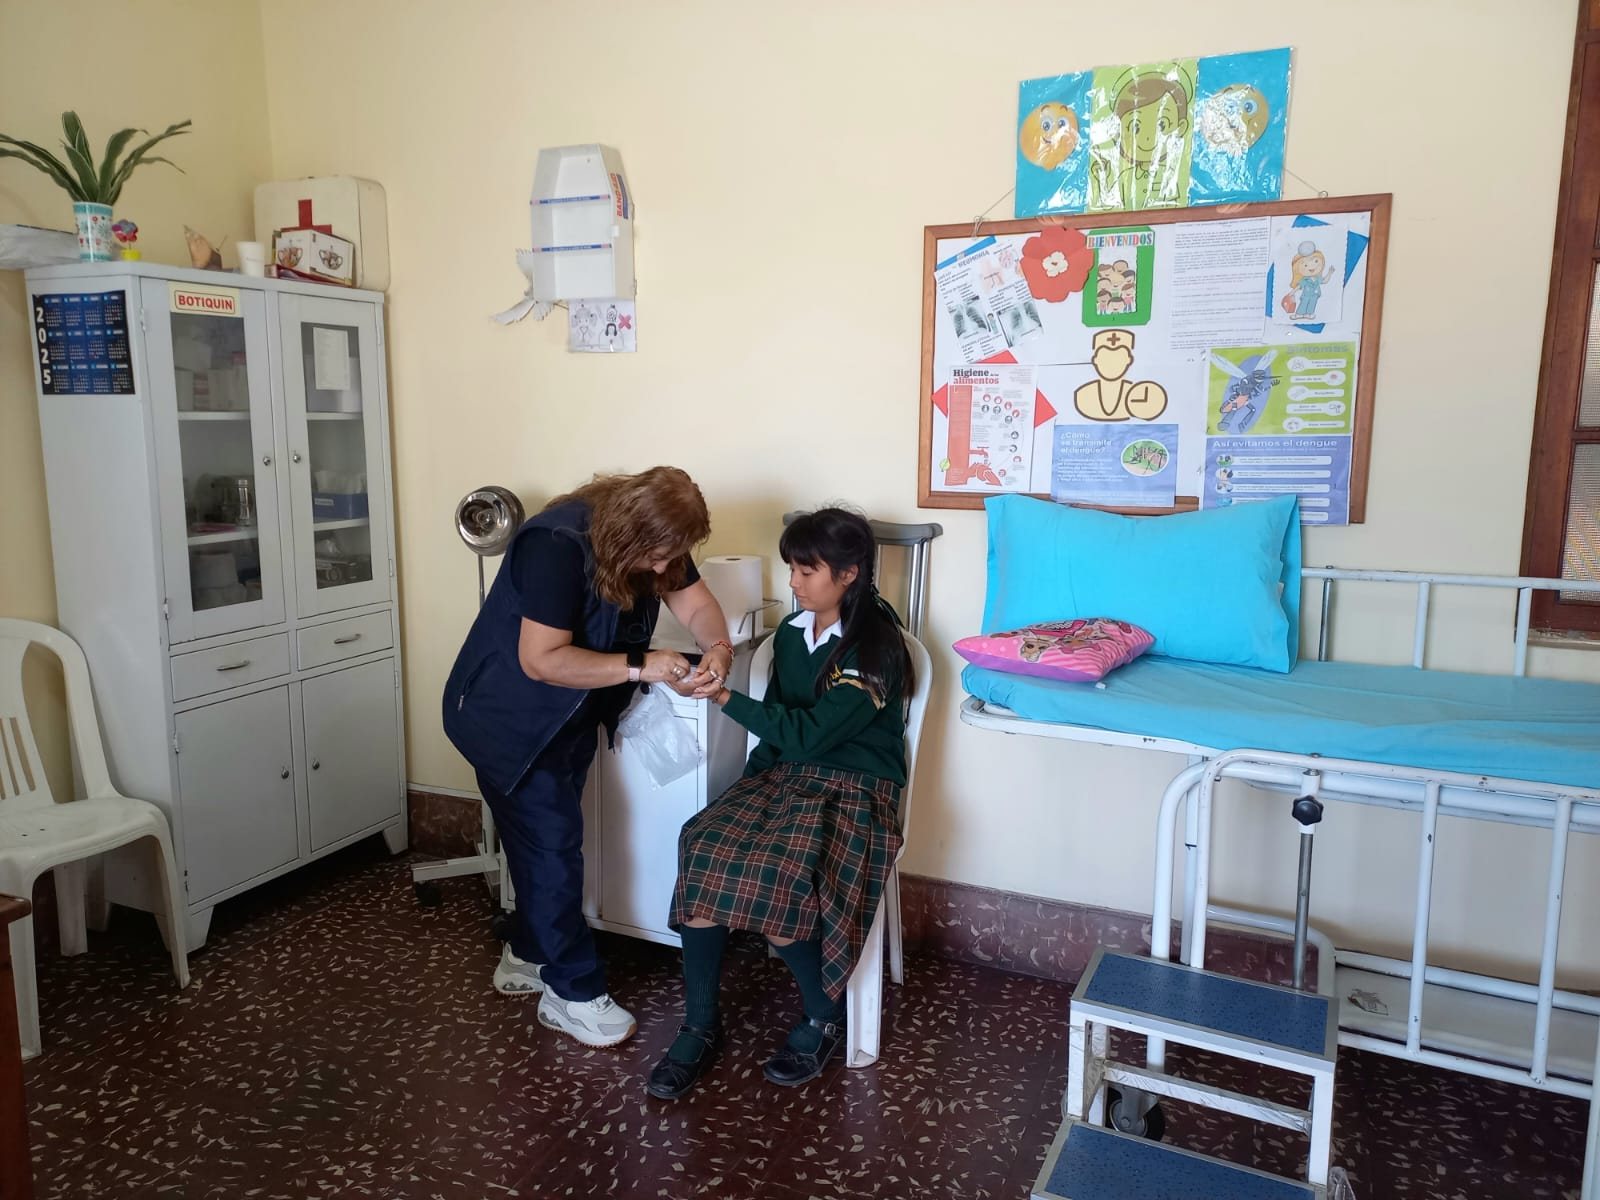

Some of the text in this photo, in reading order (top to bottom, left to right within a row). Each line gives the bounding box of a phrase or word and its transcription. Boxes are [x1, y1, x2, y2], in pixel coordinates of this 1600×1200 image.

[1087, 233, 1153, 248] BIENVENIDOS
[178, 294, 233, 310] BOTIQUIN
[36, 307, 52, 385] 2025
[953, 368, 989, 378] Higiene
[953, 376, 1000, 385] alimentos
[1213, 438, 1337, 449] Así evitamos el dengue
